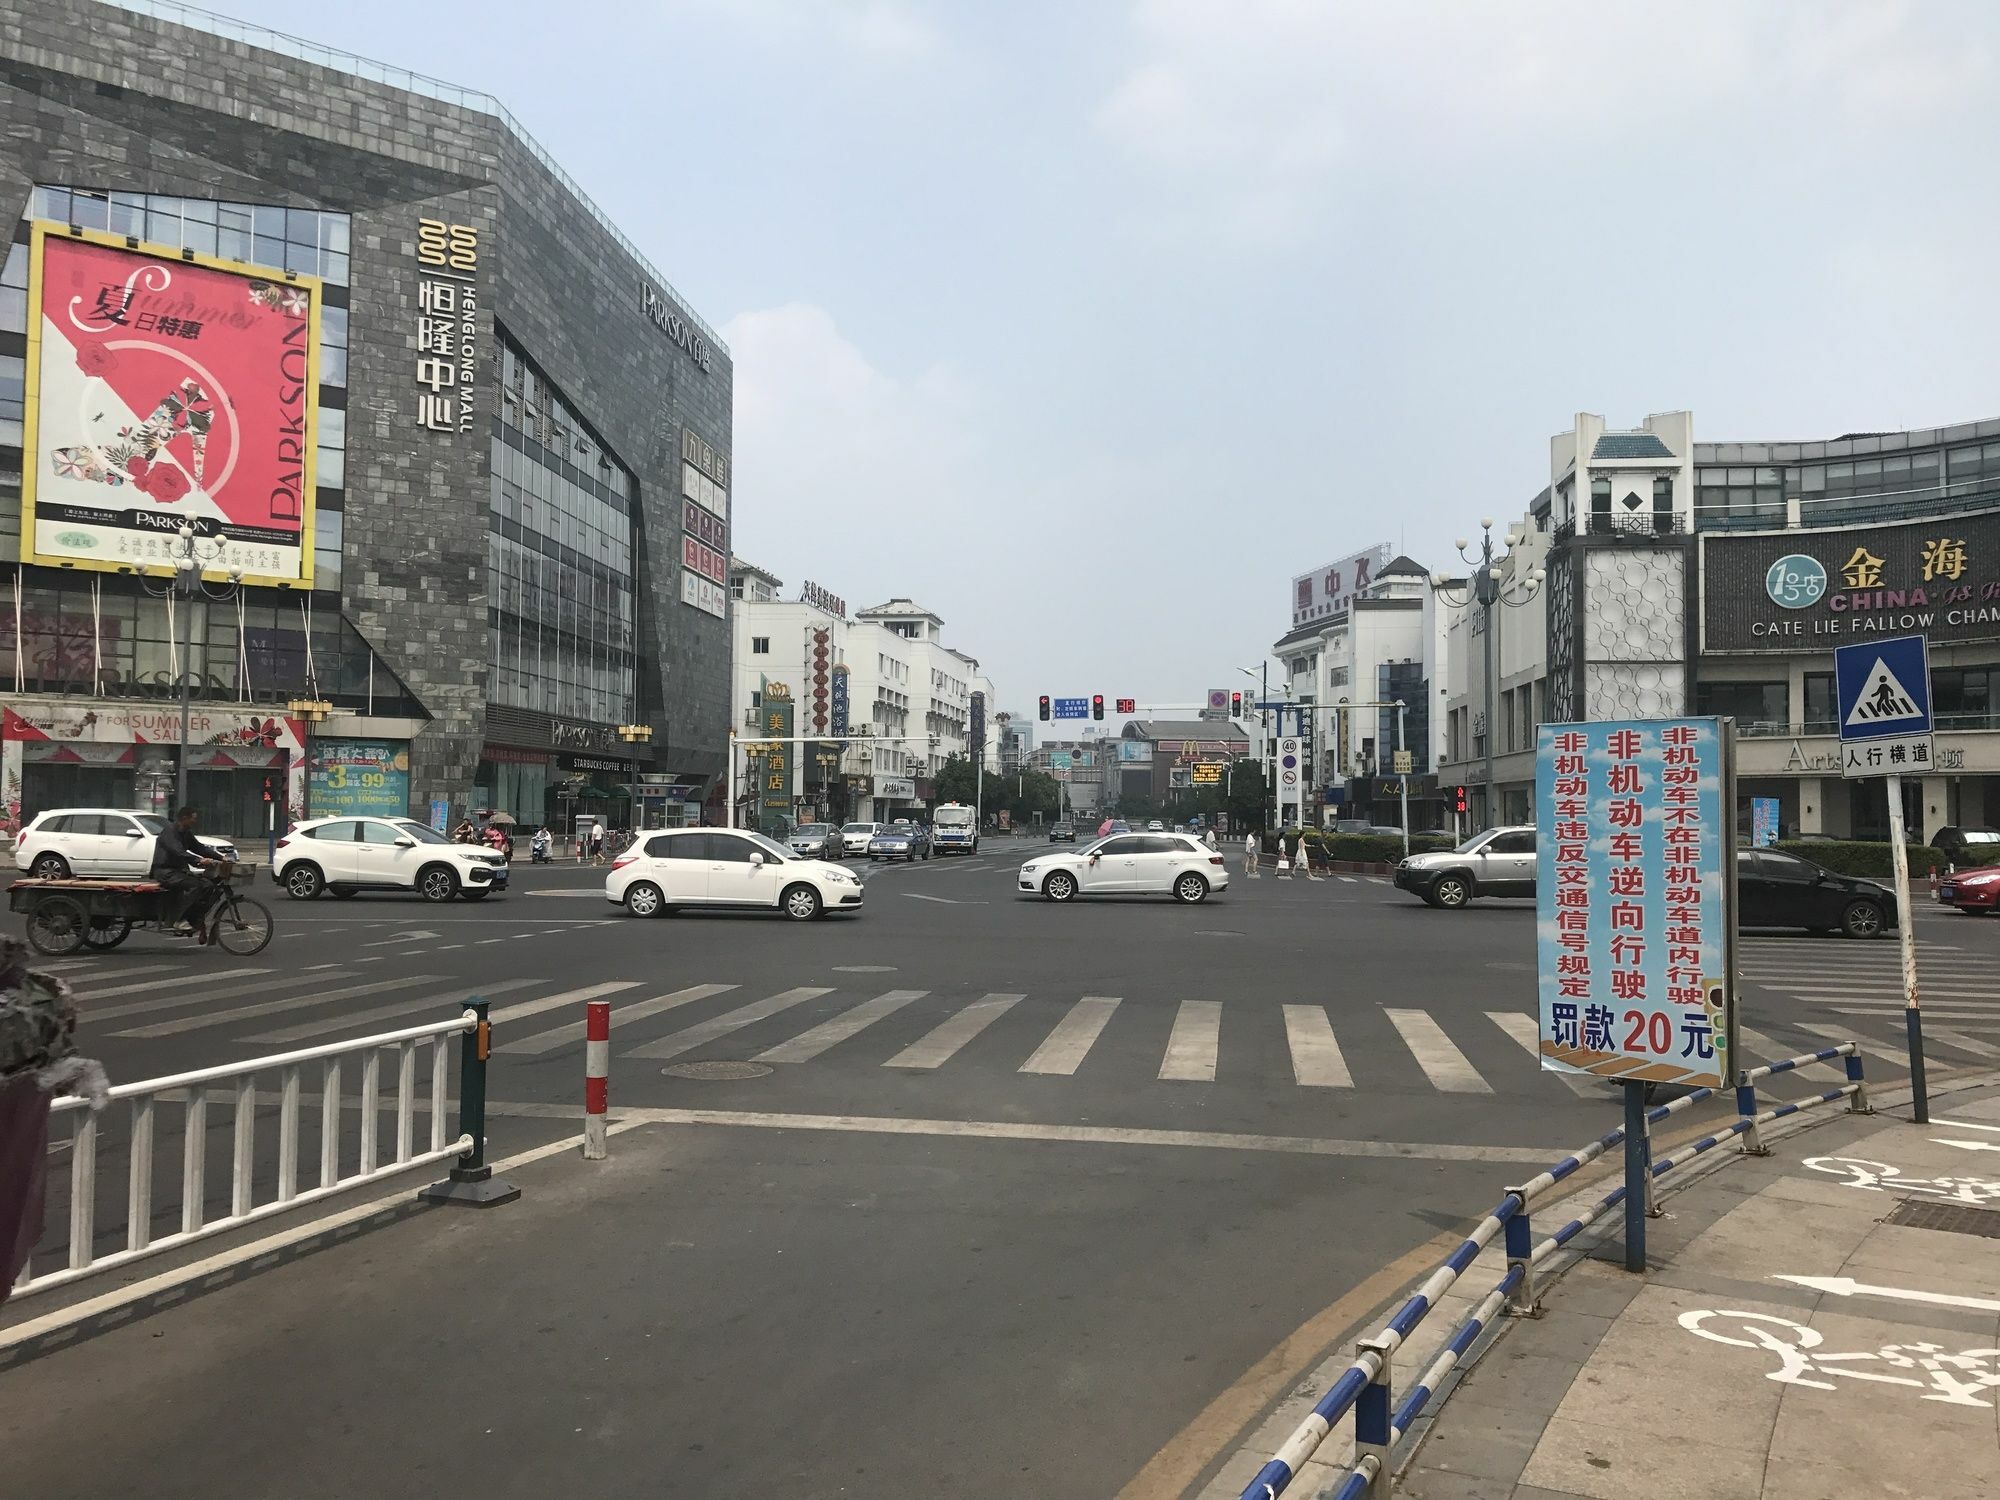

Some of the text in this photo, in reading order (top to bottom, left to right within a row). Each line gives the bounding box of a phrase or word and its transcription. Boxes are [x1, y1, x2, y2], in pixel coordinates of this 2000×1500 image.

[640, 281, 692, 355] PARKSON
[417, 280, 456, 432] 恒隆中心
[459, 286, 476, 434] HENGLONG MALL
[270, 315, 307, 522] PARKSON
[135, 511, 209, 533] PARKSON
[1841, 539, 1968, 590] 金海
[1829, 588, 1929, 612] CHINA
[1752, 621, 1803, 636] CATE
[1814, 619, 1840, 634] LIE
[1852, 612, 1935, 632] FALLOW
[107, 715, 130, 726] FOR
[153, 729, 183, 741] SAL
[573, 758, 603, 770] STARBUCKS
[602, 761, 620, 771] COFFEE
[1284, 742, 1295, 751] 40
[1846, 743, 1929, 769] 人行横道
[1554, 731, 1591, 999] 非机动车违反交通信号规定
[1607, 729, 1647, 1000] 非机动车逆向行驶
[1661, 725, 1704, 1006] 非机动车不在非机动车道内行驶
